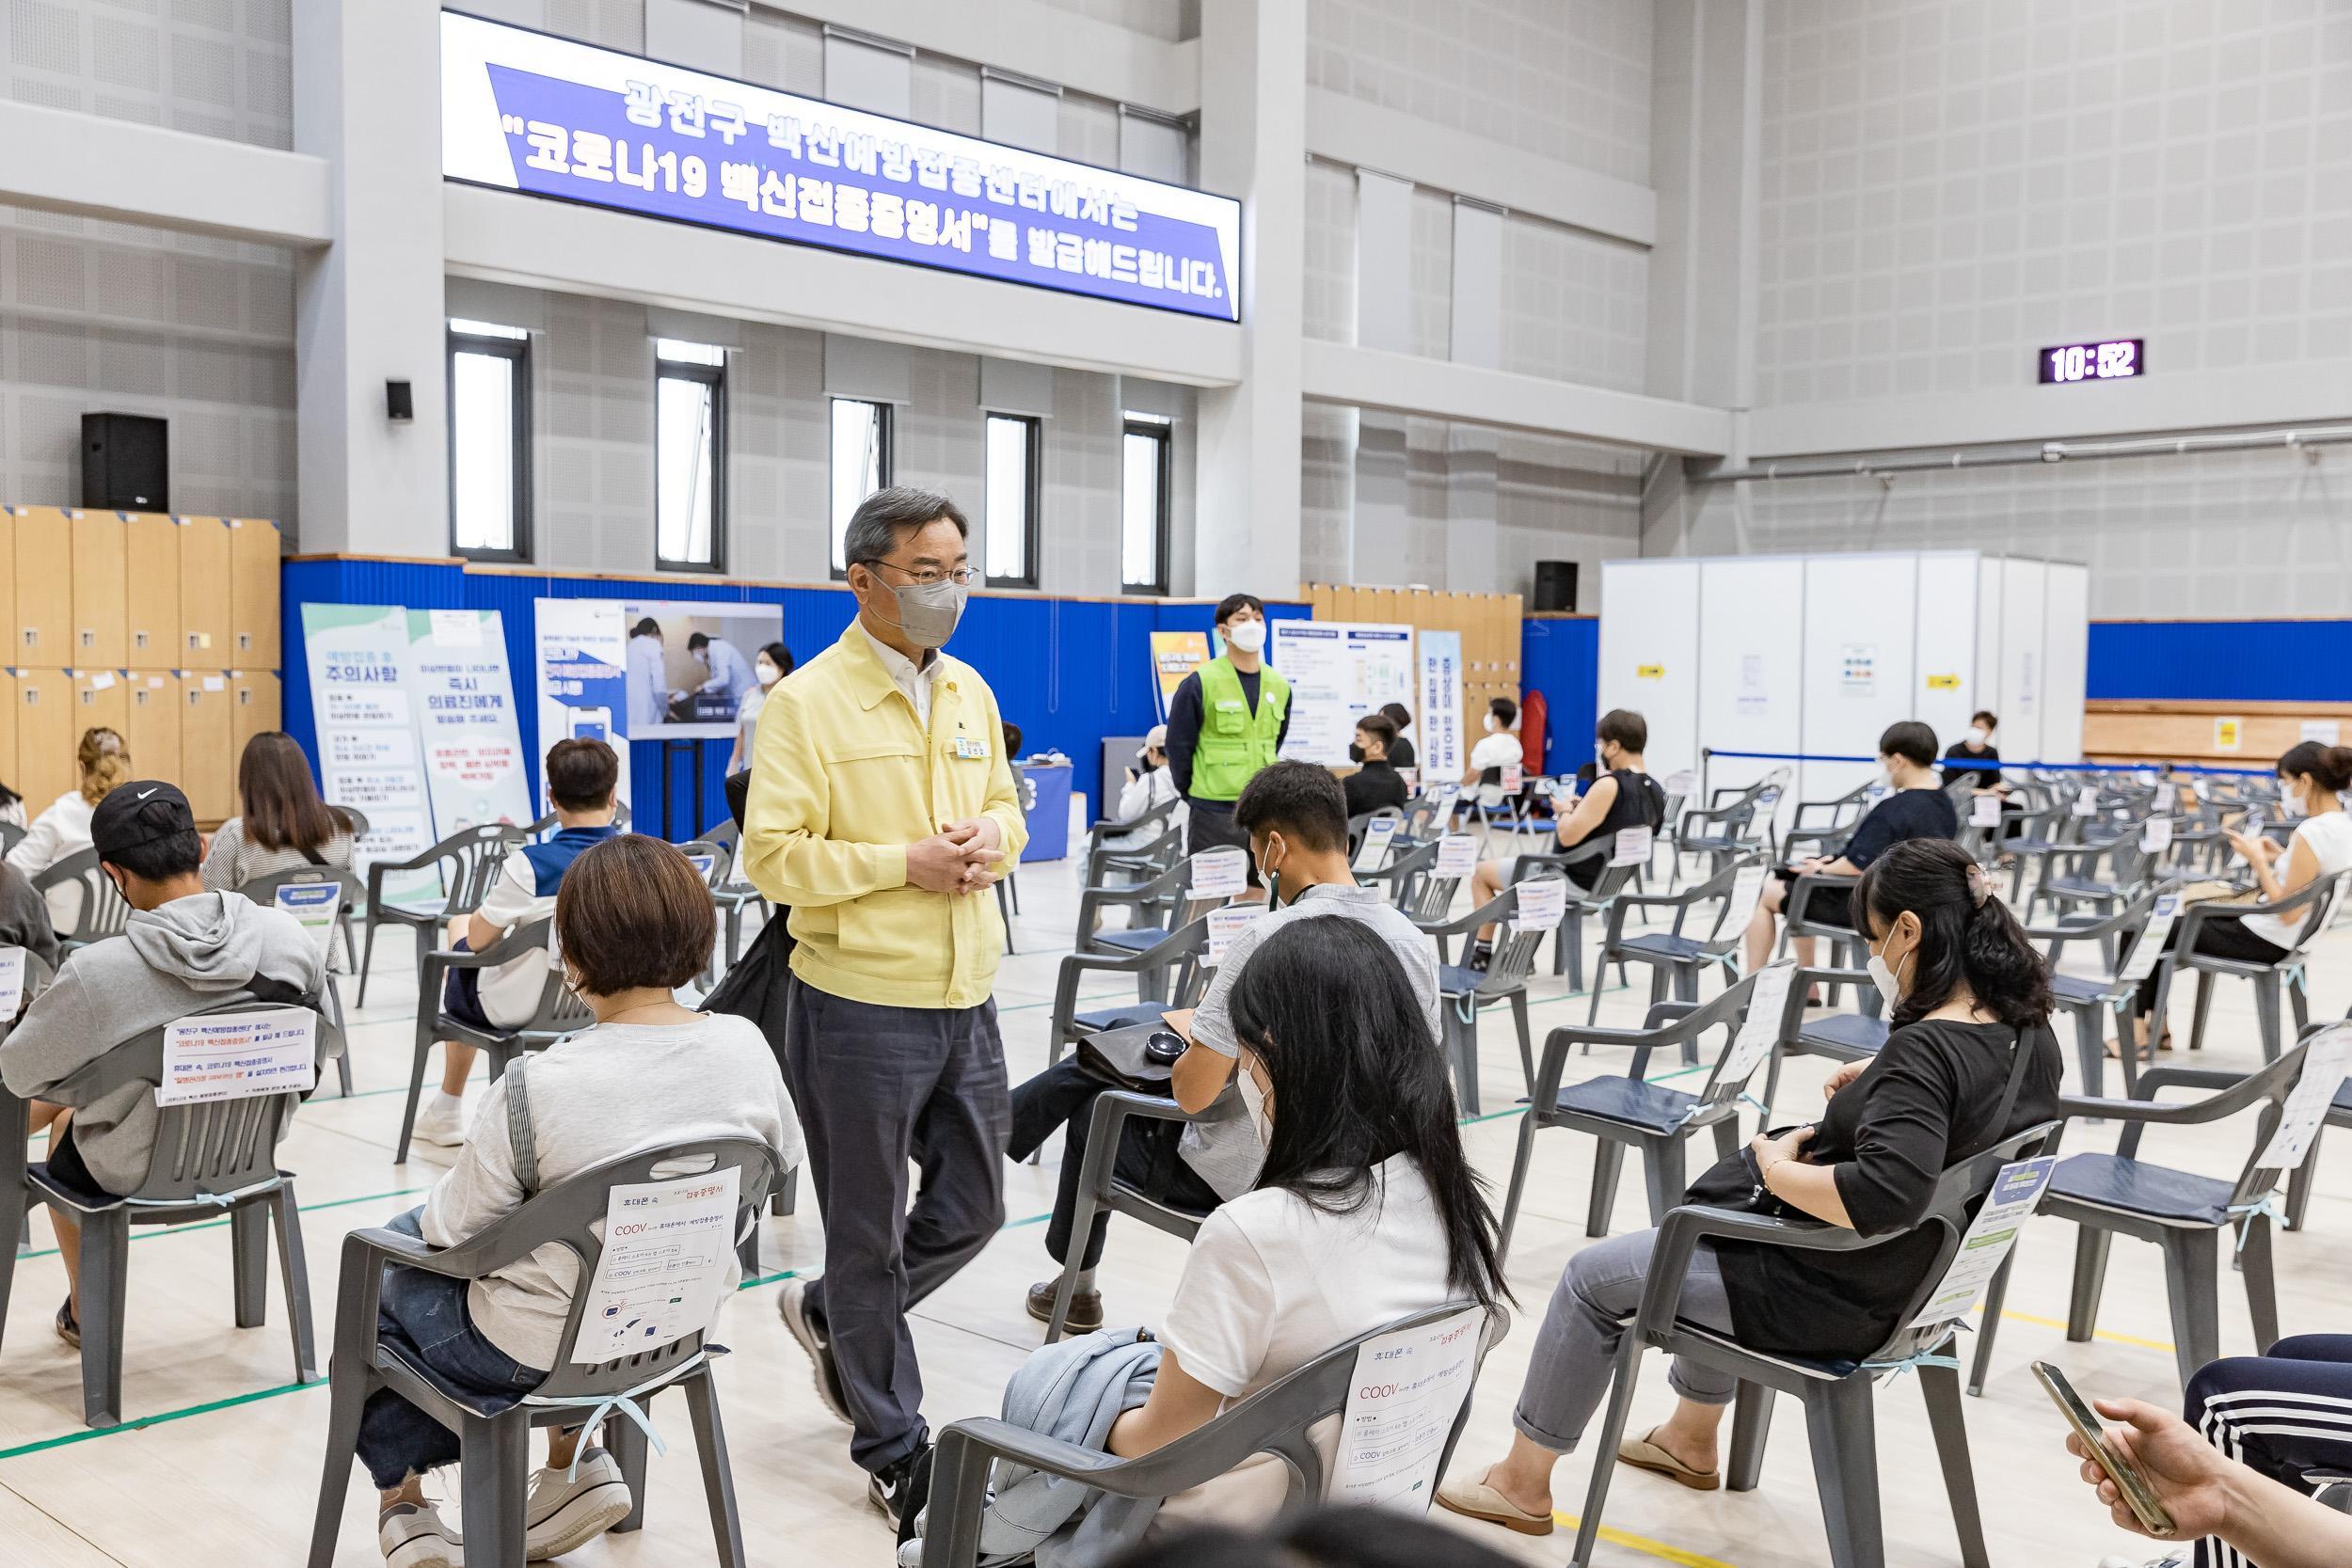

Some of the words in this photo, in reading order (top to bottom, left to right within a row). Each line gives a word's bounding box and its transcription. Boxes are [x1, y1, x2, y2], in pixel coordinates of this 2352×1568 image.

[767, 113, 1138, 232] 백신예방접종센터에서는
[1027, 226, 1223, 298] 발급해드립니다.
[2051, 341, 2136, 382] 10:52
[326, 665, 398, 682] 주의사항
[449, 677, 478, 690] 즉시
[428, 695, 503, 709] 의료진에게
[623, 1196, 649, 1206] 휴대폰
[686, 1185, 723, 1199] 접종증명서
[614, 1222, 648, 1236] COOV
[660, 1220, 687, 1229] 휴대폰에서
[689, 1214, 724, 1226] 예방접종증명서
[1374, 1348, 1404, 1361] 휴대폰
[1406, 1347, 1413, 1355] 속
[1440, 1321, 1472, 1346] 접종증명서
[1359, 1382, 1400, 1400] COOV
[1411, 1373, 1436, 1390] 휴대폰에서
[1363, 1428, 1380, 1437] 플레이
[1359, 1450, 1382, 1460] COOV
